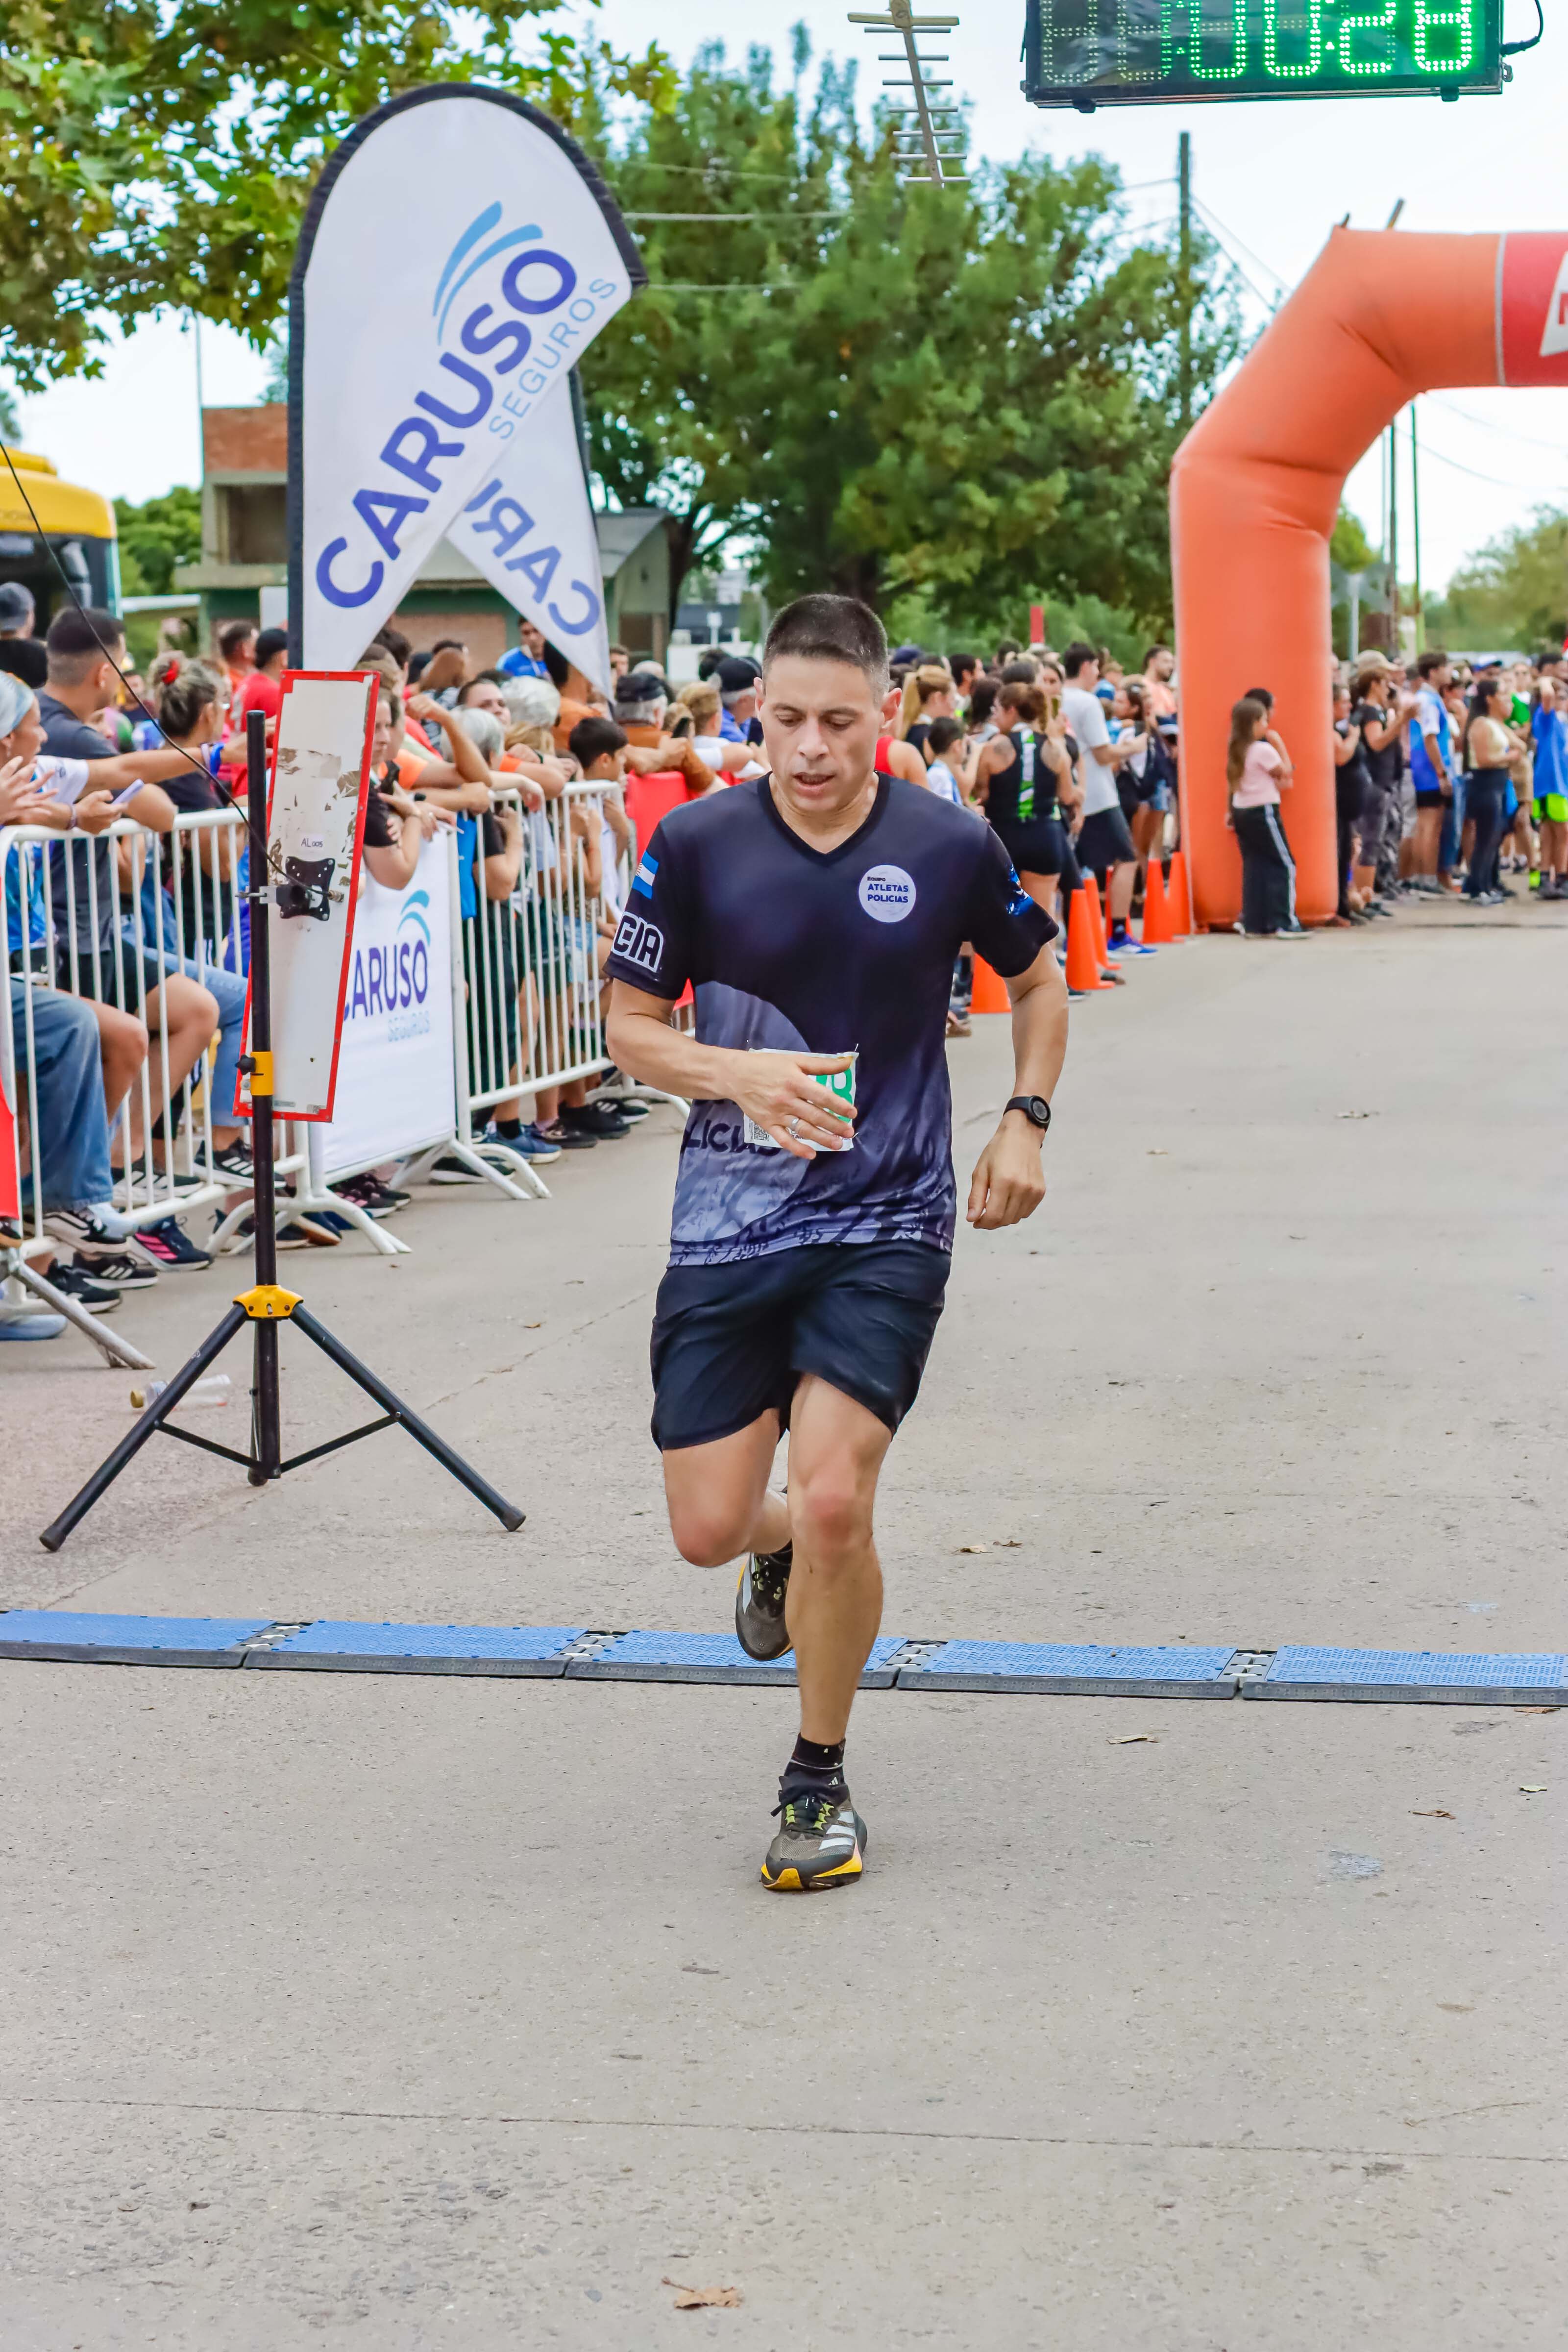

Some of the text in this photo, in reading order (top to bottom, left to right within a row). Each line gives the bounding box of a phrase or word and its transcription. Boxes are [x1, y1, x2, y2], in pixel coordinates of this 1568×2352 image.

[489, 278, 617, 440] SEGUROS
[316, 249, 577, 608] CARUSO
[301, 838, 311, 847] AL
[867, 894, 908, 903] POLICIAS
[868, 883, 908, 892] ATLETAS
[344, 939, 428, 1022] ARUSO
